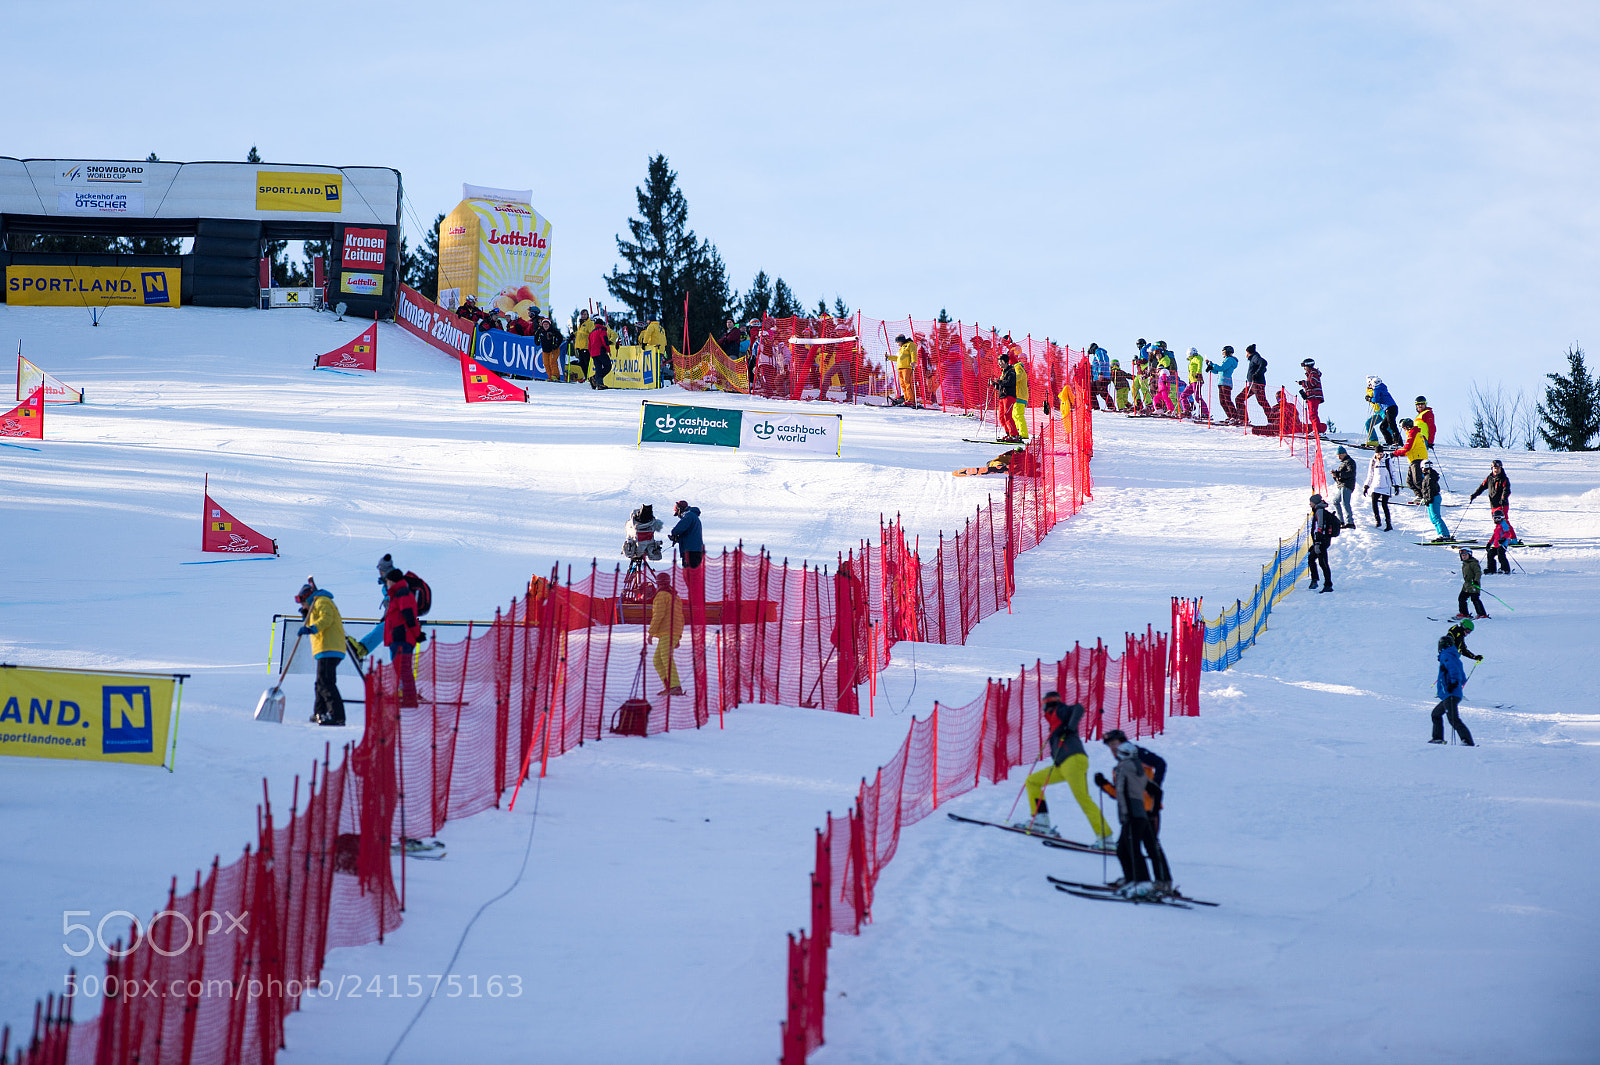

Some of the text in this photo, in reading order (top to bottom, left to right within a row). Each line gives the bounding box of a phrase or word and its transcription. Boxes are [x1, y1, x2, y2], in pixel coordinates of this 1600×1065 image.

[86, 165, 144, 174] SNOWBOARD
[75, 192, 114, 200] Lackenhof
[258, 186, 323, 195] SPORT.LAND.
[75, 198, 127, 208] ÖTSCHER
[345, 233, 385, 249] Kronen
[487, 228, 547, 249] Lattella
[344, 247, 384, 264] Zeitung
[9, 277, 137, 293] SPORT.LAND.
[145, 275, 164, 292] N
[347, 277, 377, 287] Lattella
[398, 290, 471, 355] Kronen Zeitung
[503, 341, 563, 375] UNI
[655, 414, 729, 429] cb cashback
[753, 421, 827, 436] cb cashback
[678, 427, 708, 436] world
[777, 433, 807, 443] world
[110, 693, 145, 729] N
